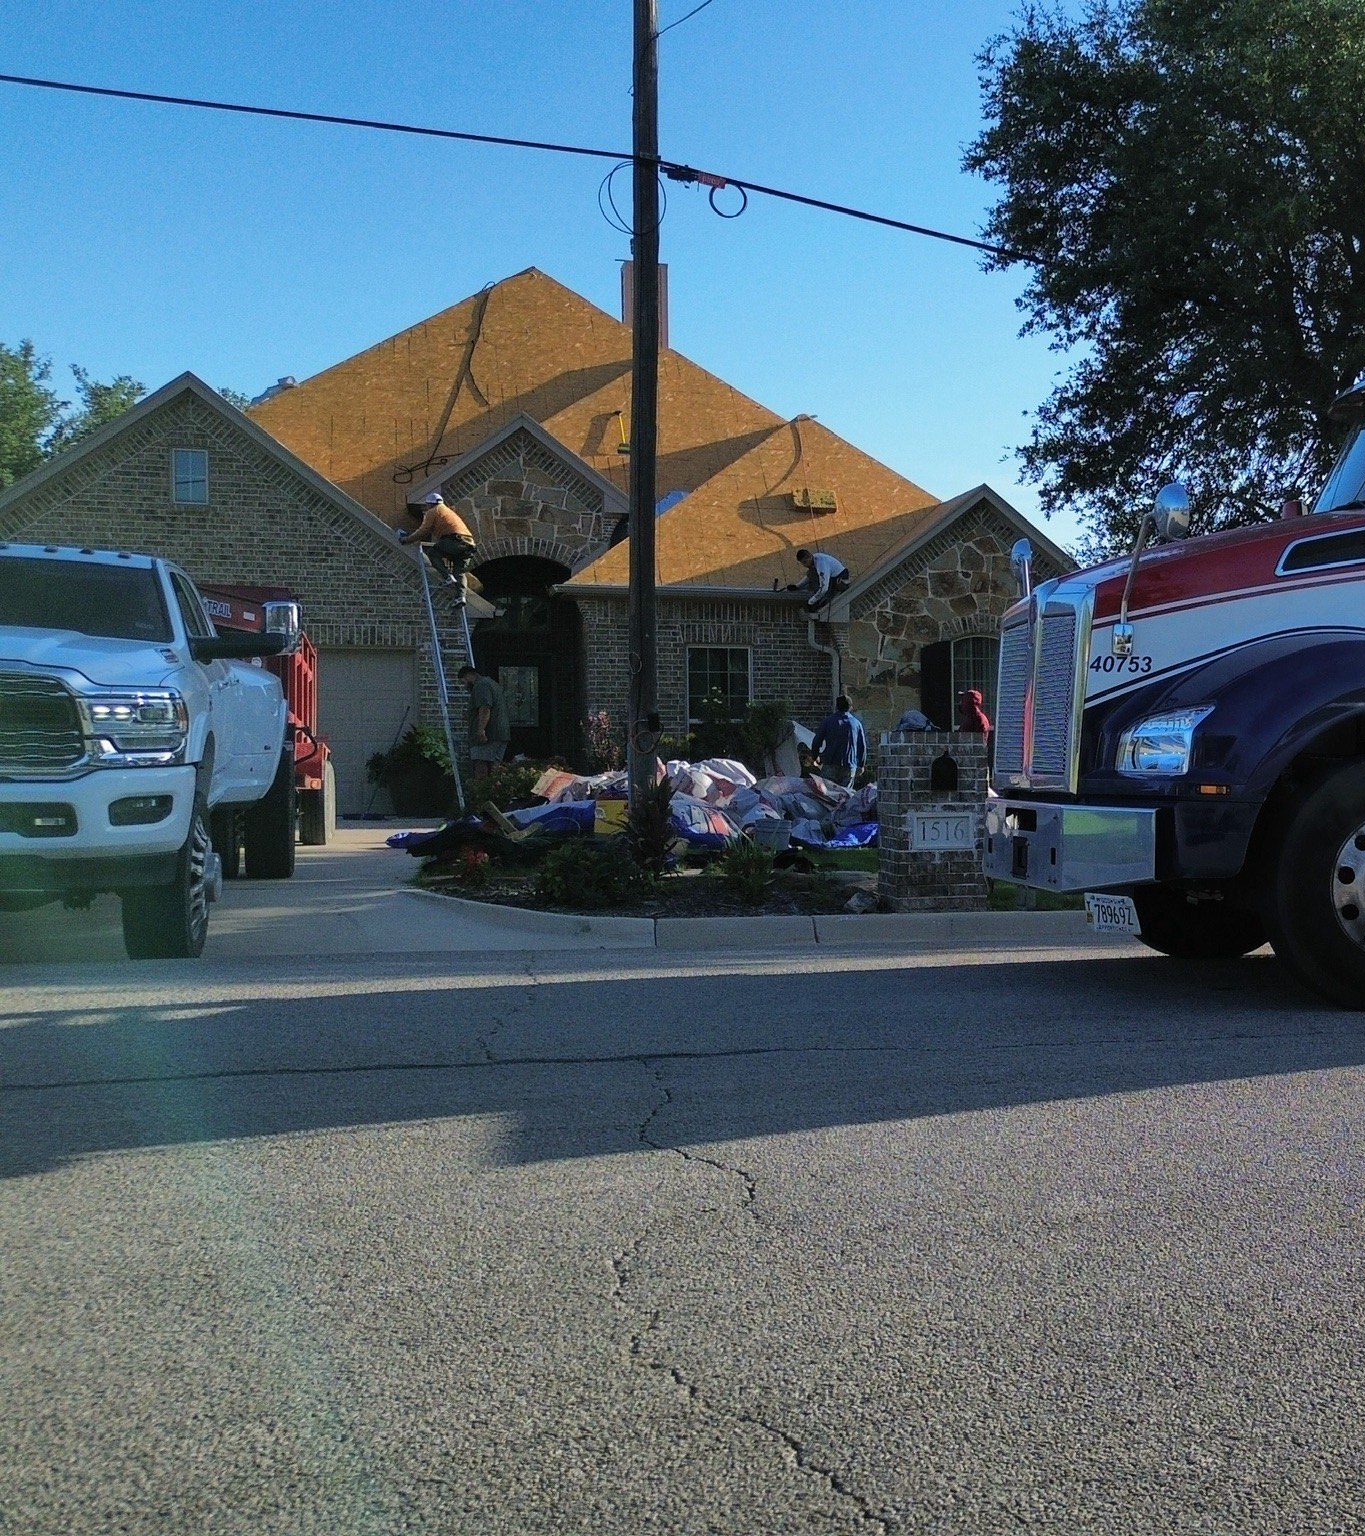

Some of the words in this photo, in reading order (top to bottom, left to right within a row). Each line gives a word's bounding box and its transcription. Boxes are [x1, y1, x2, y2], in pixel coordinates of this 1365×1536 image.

[1089, 655, 1153, 673] 40753
[920, 820, 965, 841] 1516
[1094, 904, 1134, 925] 78969Z
